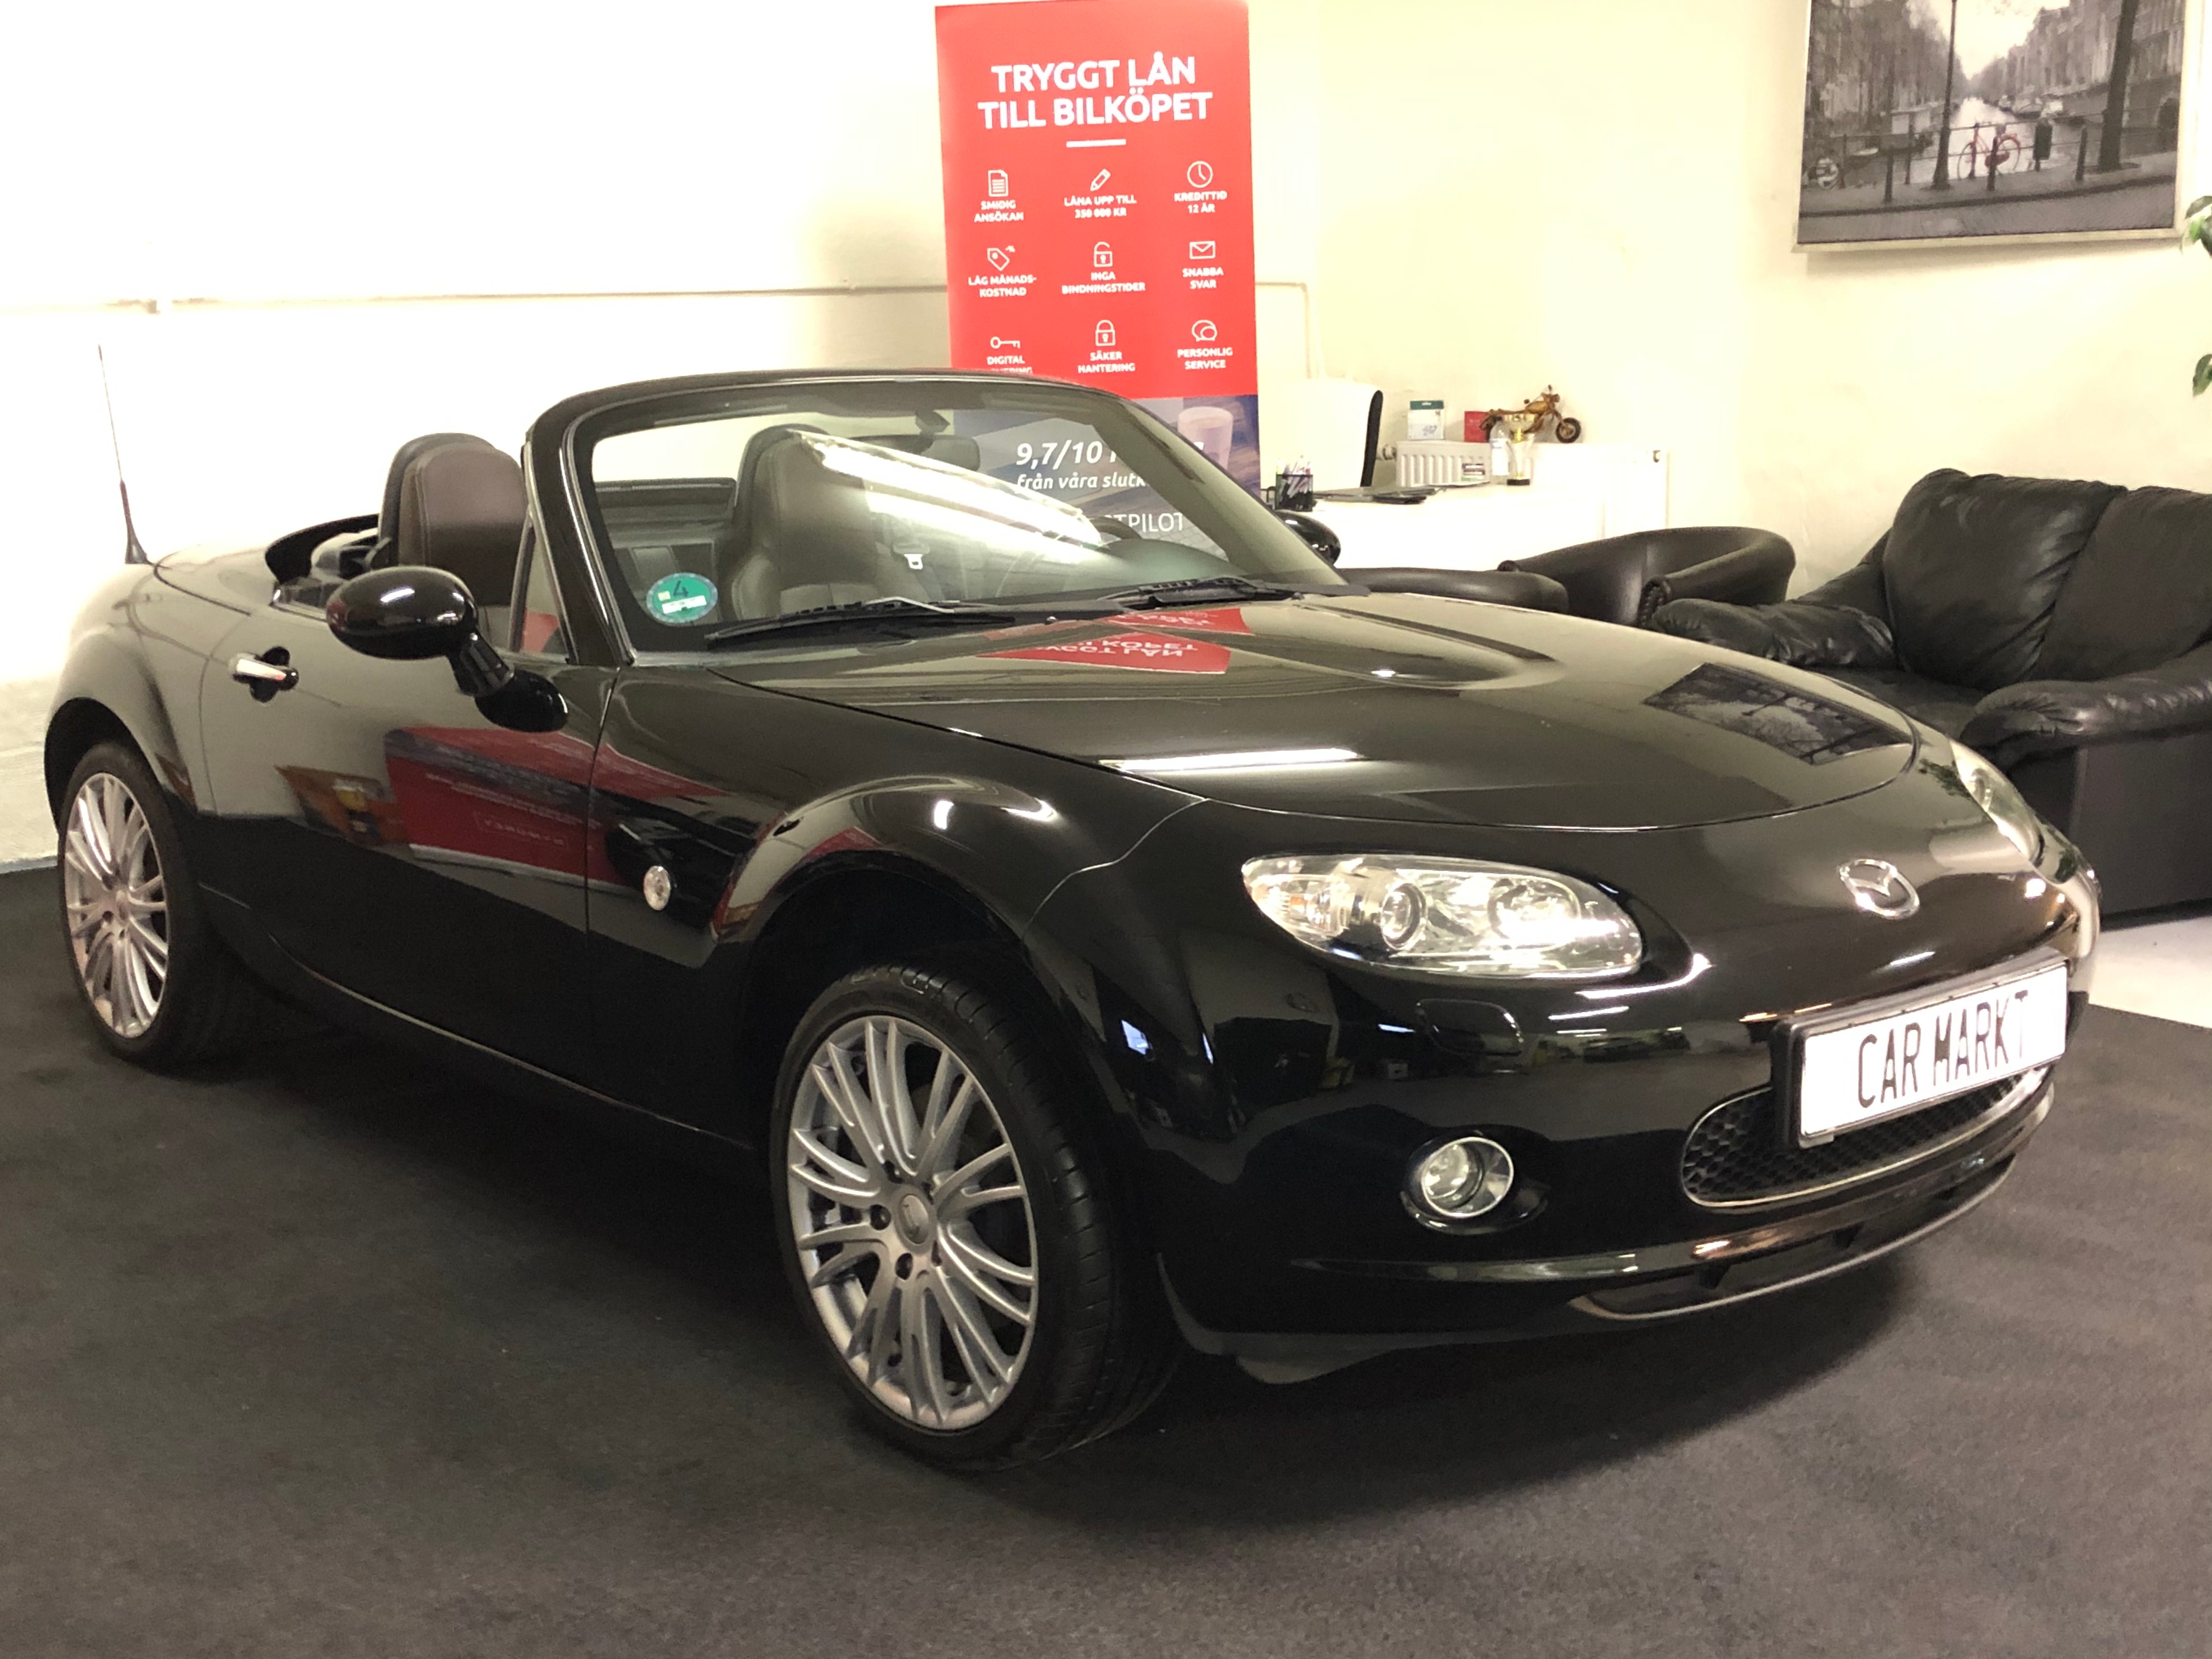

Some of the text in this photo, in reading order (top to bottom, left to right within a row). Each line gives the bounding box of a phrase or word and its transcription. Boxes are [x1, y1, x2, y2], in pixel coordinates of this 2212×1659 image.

[991, 51, 1196, 93] TRYGGT LÅN
[977, 87, 1213, 129] TILL BILKÖPET
[1064, 194, 1137, 206] LÅNA UPP TILL
[1173, 190, 1227, 202] KREDITTID
[981, 200, 1016, 210] SMIDIG
[1188, 202, 1215, 213] 12 ÅR
[974, 211, 1024, 223] ANSÖKAN
[1113, 207, 1127, 217] KR
[1091, 271, 1116, 281] INGA
[1182, 267, 1224, 278] SNABBA
[968, 274, 1037, 286] LÅG MÅNADS-
[1189, 279, 1217, 290] SVAR
[979, 287, 1027, 298] KOSTNAD
[1062, 282, 1146, 295] BINDNINGSTIDER
[1090, 351, 1122, 361] SÄKER
[1177, 347, 1233, 358] PERSONLIG
[987, 355, 1025, 365] DIGITAL
[1184, 359, 1226, 370] SERVICE
[1077, 363, 1136, 374] HANTERING
[1016, 439, 1103, 470] 9,7/10
[1017, 473, 1053, 490] från
[1059, 472, 1098, 488] våra
[1858, 989, 2029, 1108] CAR MARKT
